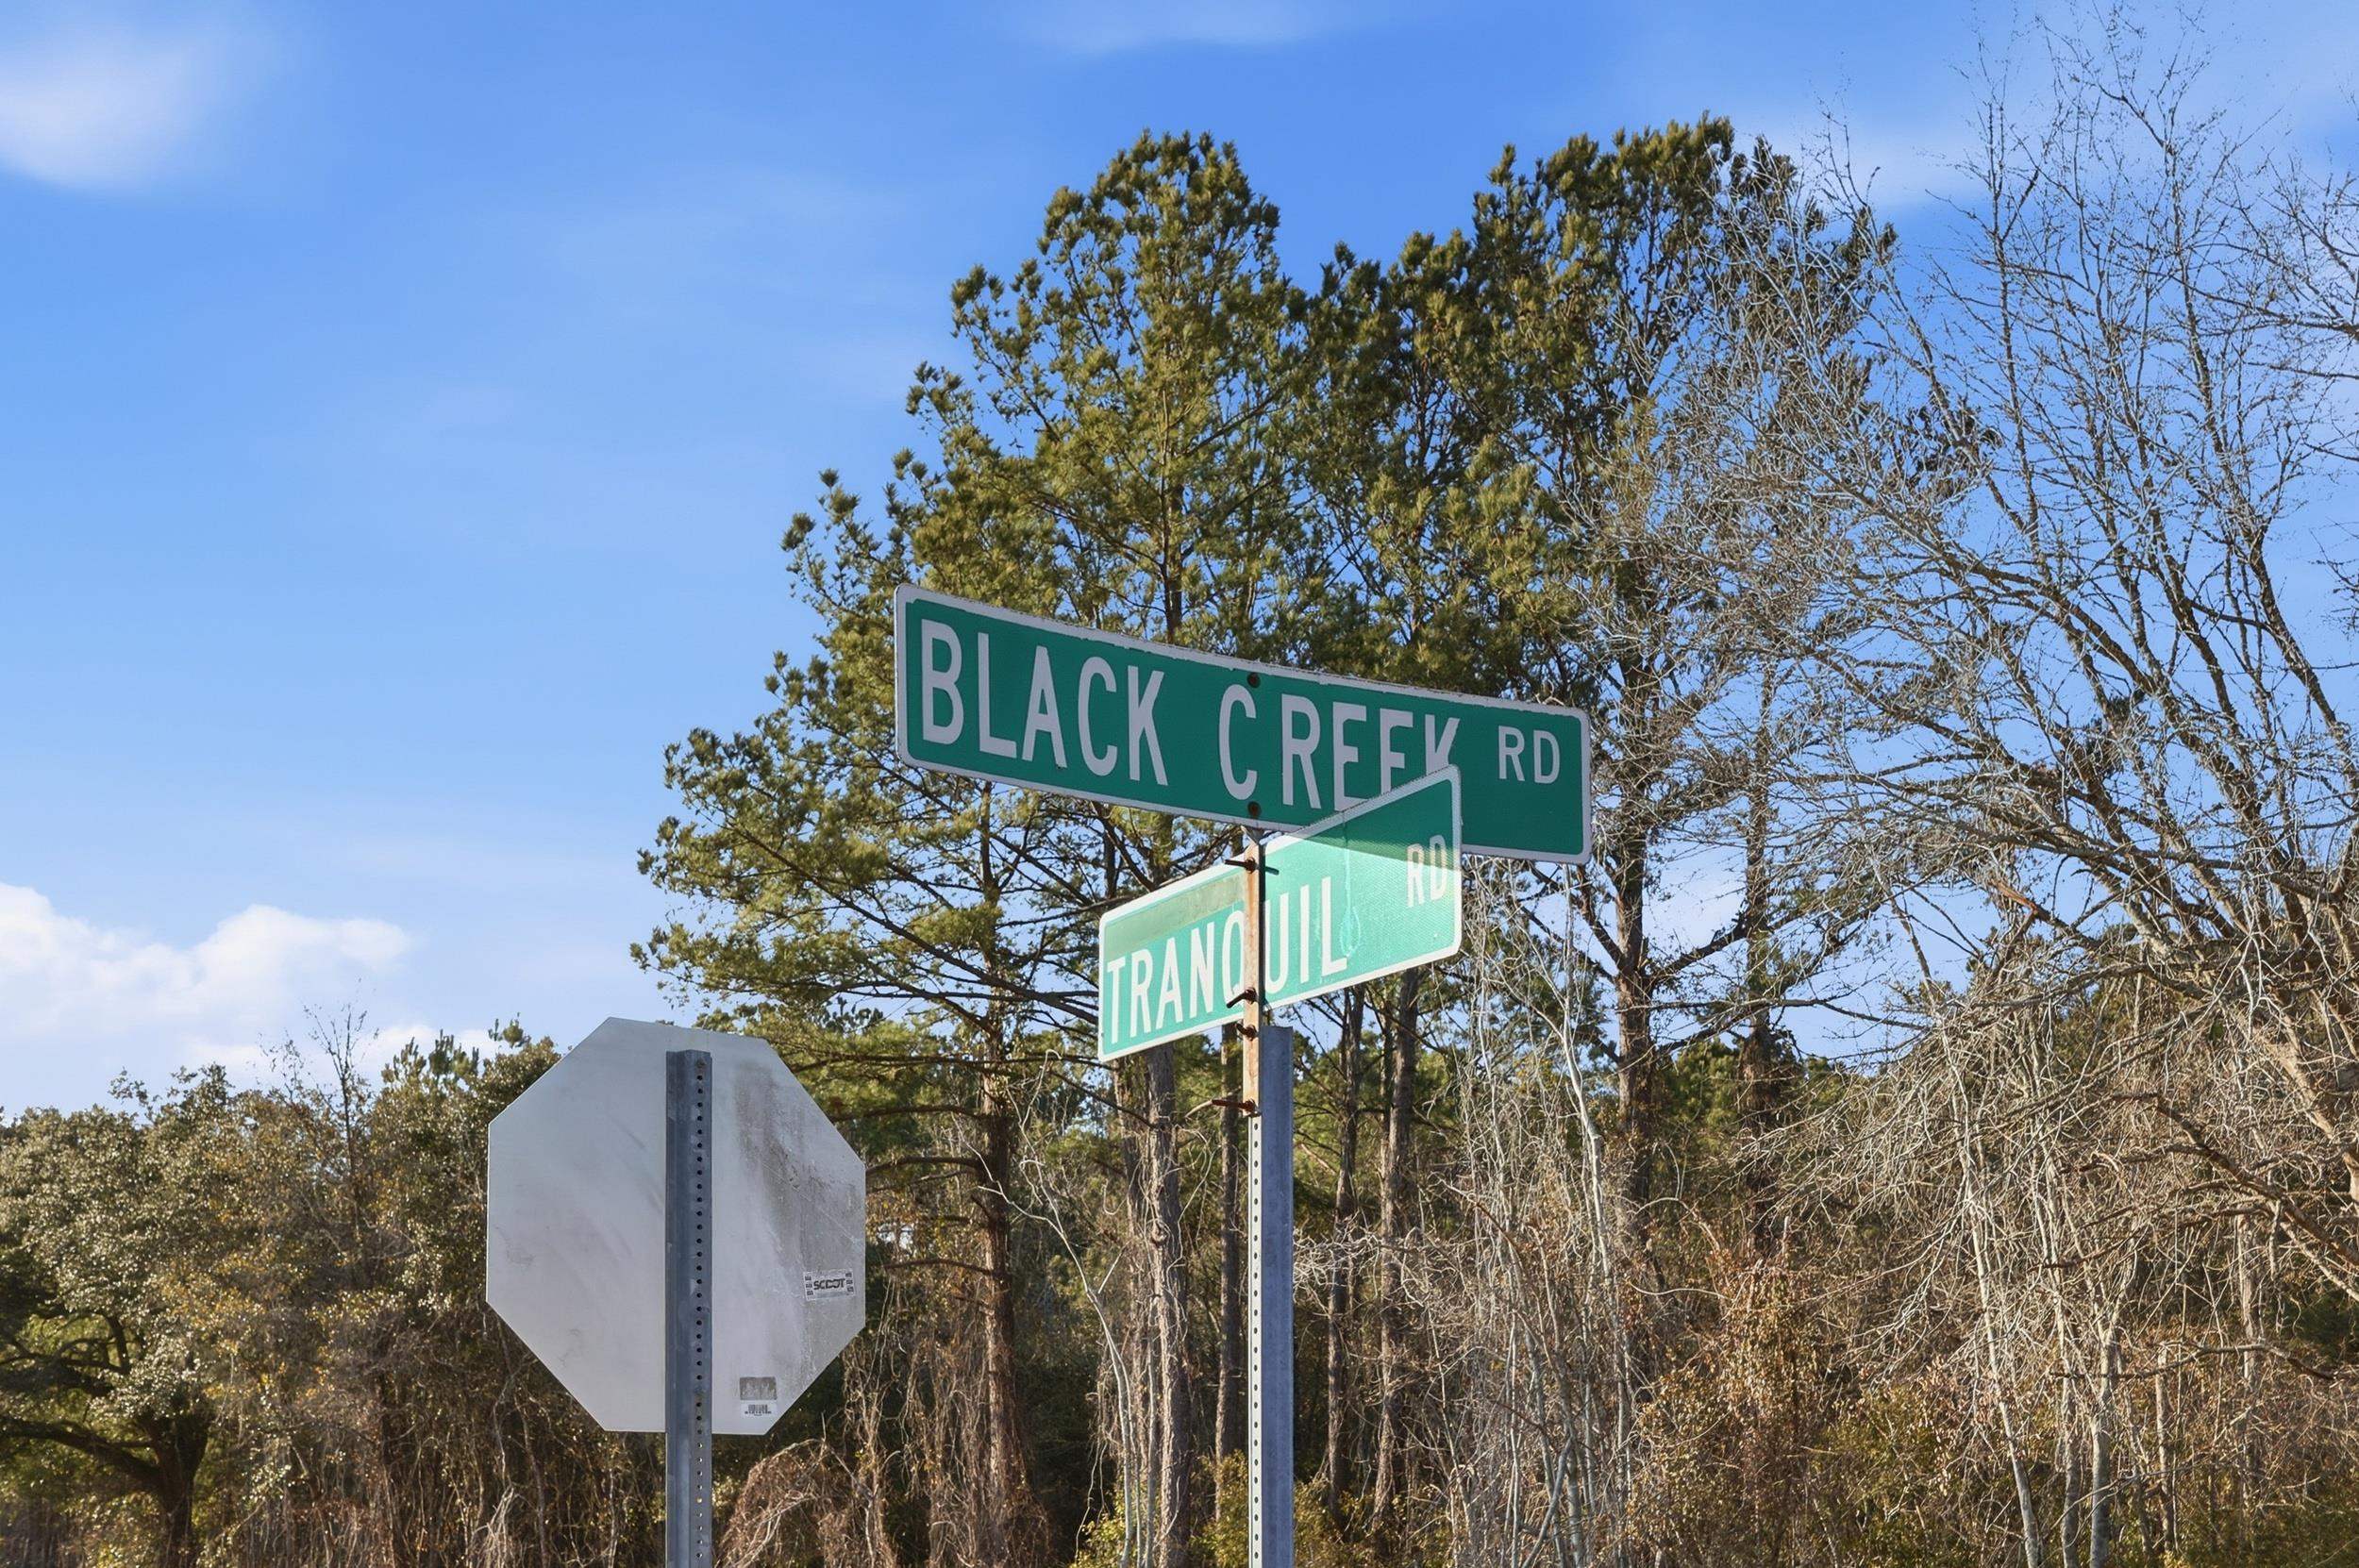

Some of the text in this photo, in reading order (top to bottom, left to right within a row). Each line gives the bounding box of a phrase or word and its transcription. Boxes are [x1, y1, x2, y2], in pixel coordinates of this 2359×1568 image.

[921, 619, 1560, 811] BLACK CREEK RD
[1107, 834, 1448, 1044] TRANQUIL RD
[813, 1278, 845, 1291] SCDOT
